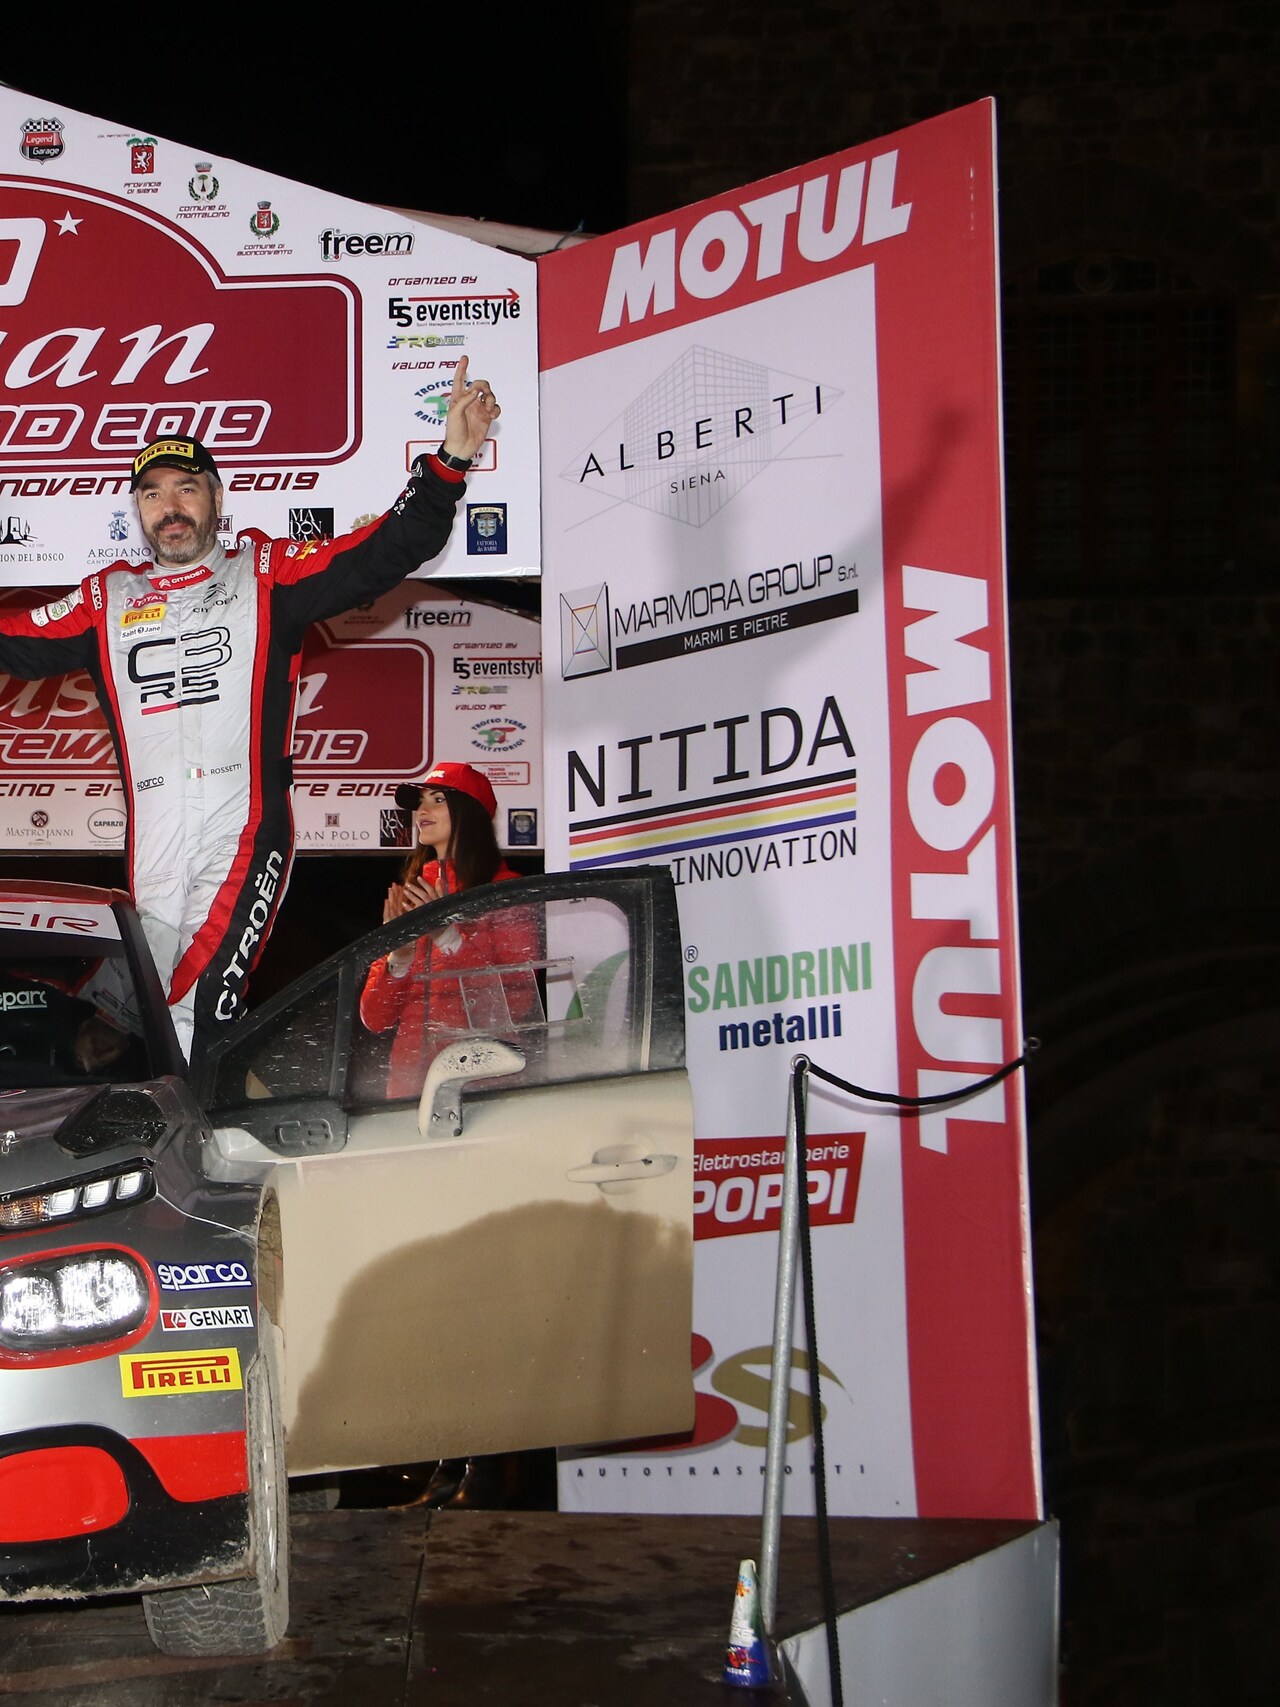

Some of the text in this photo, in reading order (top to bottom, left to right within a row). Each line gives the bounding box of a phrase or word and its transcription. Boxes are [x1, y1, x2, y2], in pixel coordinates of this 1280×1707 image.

[26, 134, 53, 145] Legend
[32, 146, 60, 156] Garage
[321, 231, 414, 255] freem
[598, 149, 912, 333] MOTUL
[416, 299, 520, 325] eventstyle
[91, 400, 272, 450] 2019
[580, 385, 822, 483] ALBERTI
[137, 442, 189, 468] PIRELLI
[228, 472, 320, 492] 2019
[670, 469, 726, 494] SIENA
[18, 554, 34, 562] DEL
[37, 553, 64, 561] BOSCO
[88, 547, 151, 558] ARGIANO
[259, 542, 272, 574] sparco
[136, 595, 166, 607] TOTAL
[614, 578, 744, 637] MARMORA
[747, 554, 834, 604] GROUP
[124, 608, 161, 624] PIRELLI
[406, 608, 471, 627] freem
[122, 626, 161, 639] Saint Jane
[683, 612, 789, 650] MARMI E PIETRE
[568, 695, 856, 812] NITIDA
[210, 763, 242, 775] ROSSETTI
[137, 776, 164, 791] sparco
[6, 827, 74, 838] MASTRO JANNI
[93, 820, 123, 828] CAPARZO
[331, 831, 370, 840] POLO
[671, 826, 857, 886] INNOVATION
[902, 565, 1006, 1154] MOTUL
[688, 941, 873, 1014] SANDRINI
[719, 1004, 842, 1051] metalli
[157, 1262, 249, 1291] sparco
[189, 1309, 249, 1327] GENART
[131, 1356, 231, 1389] PIRELLI
